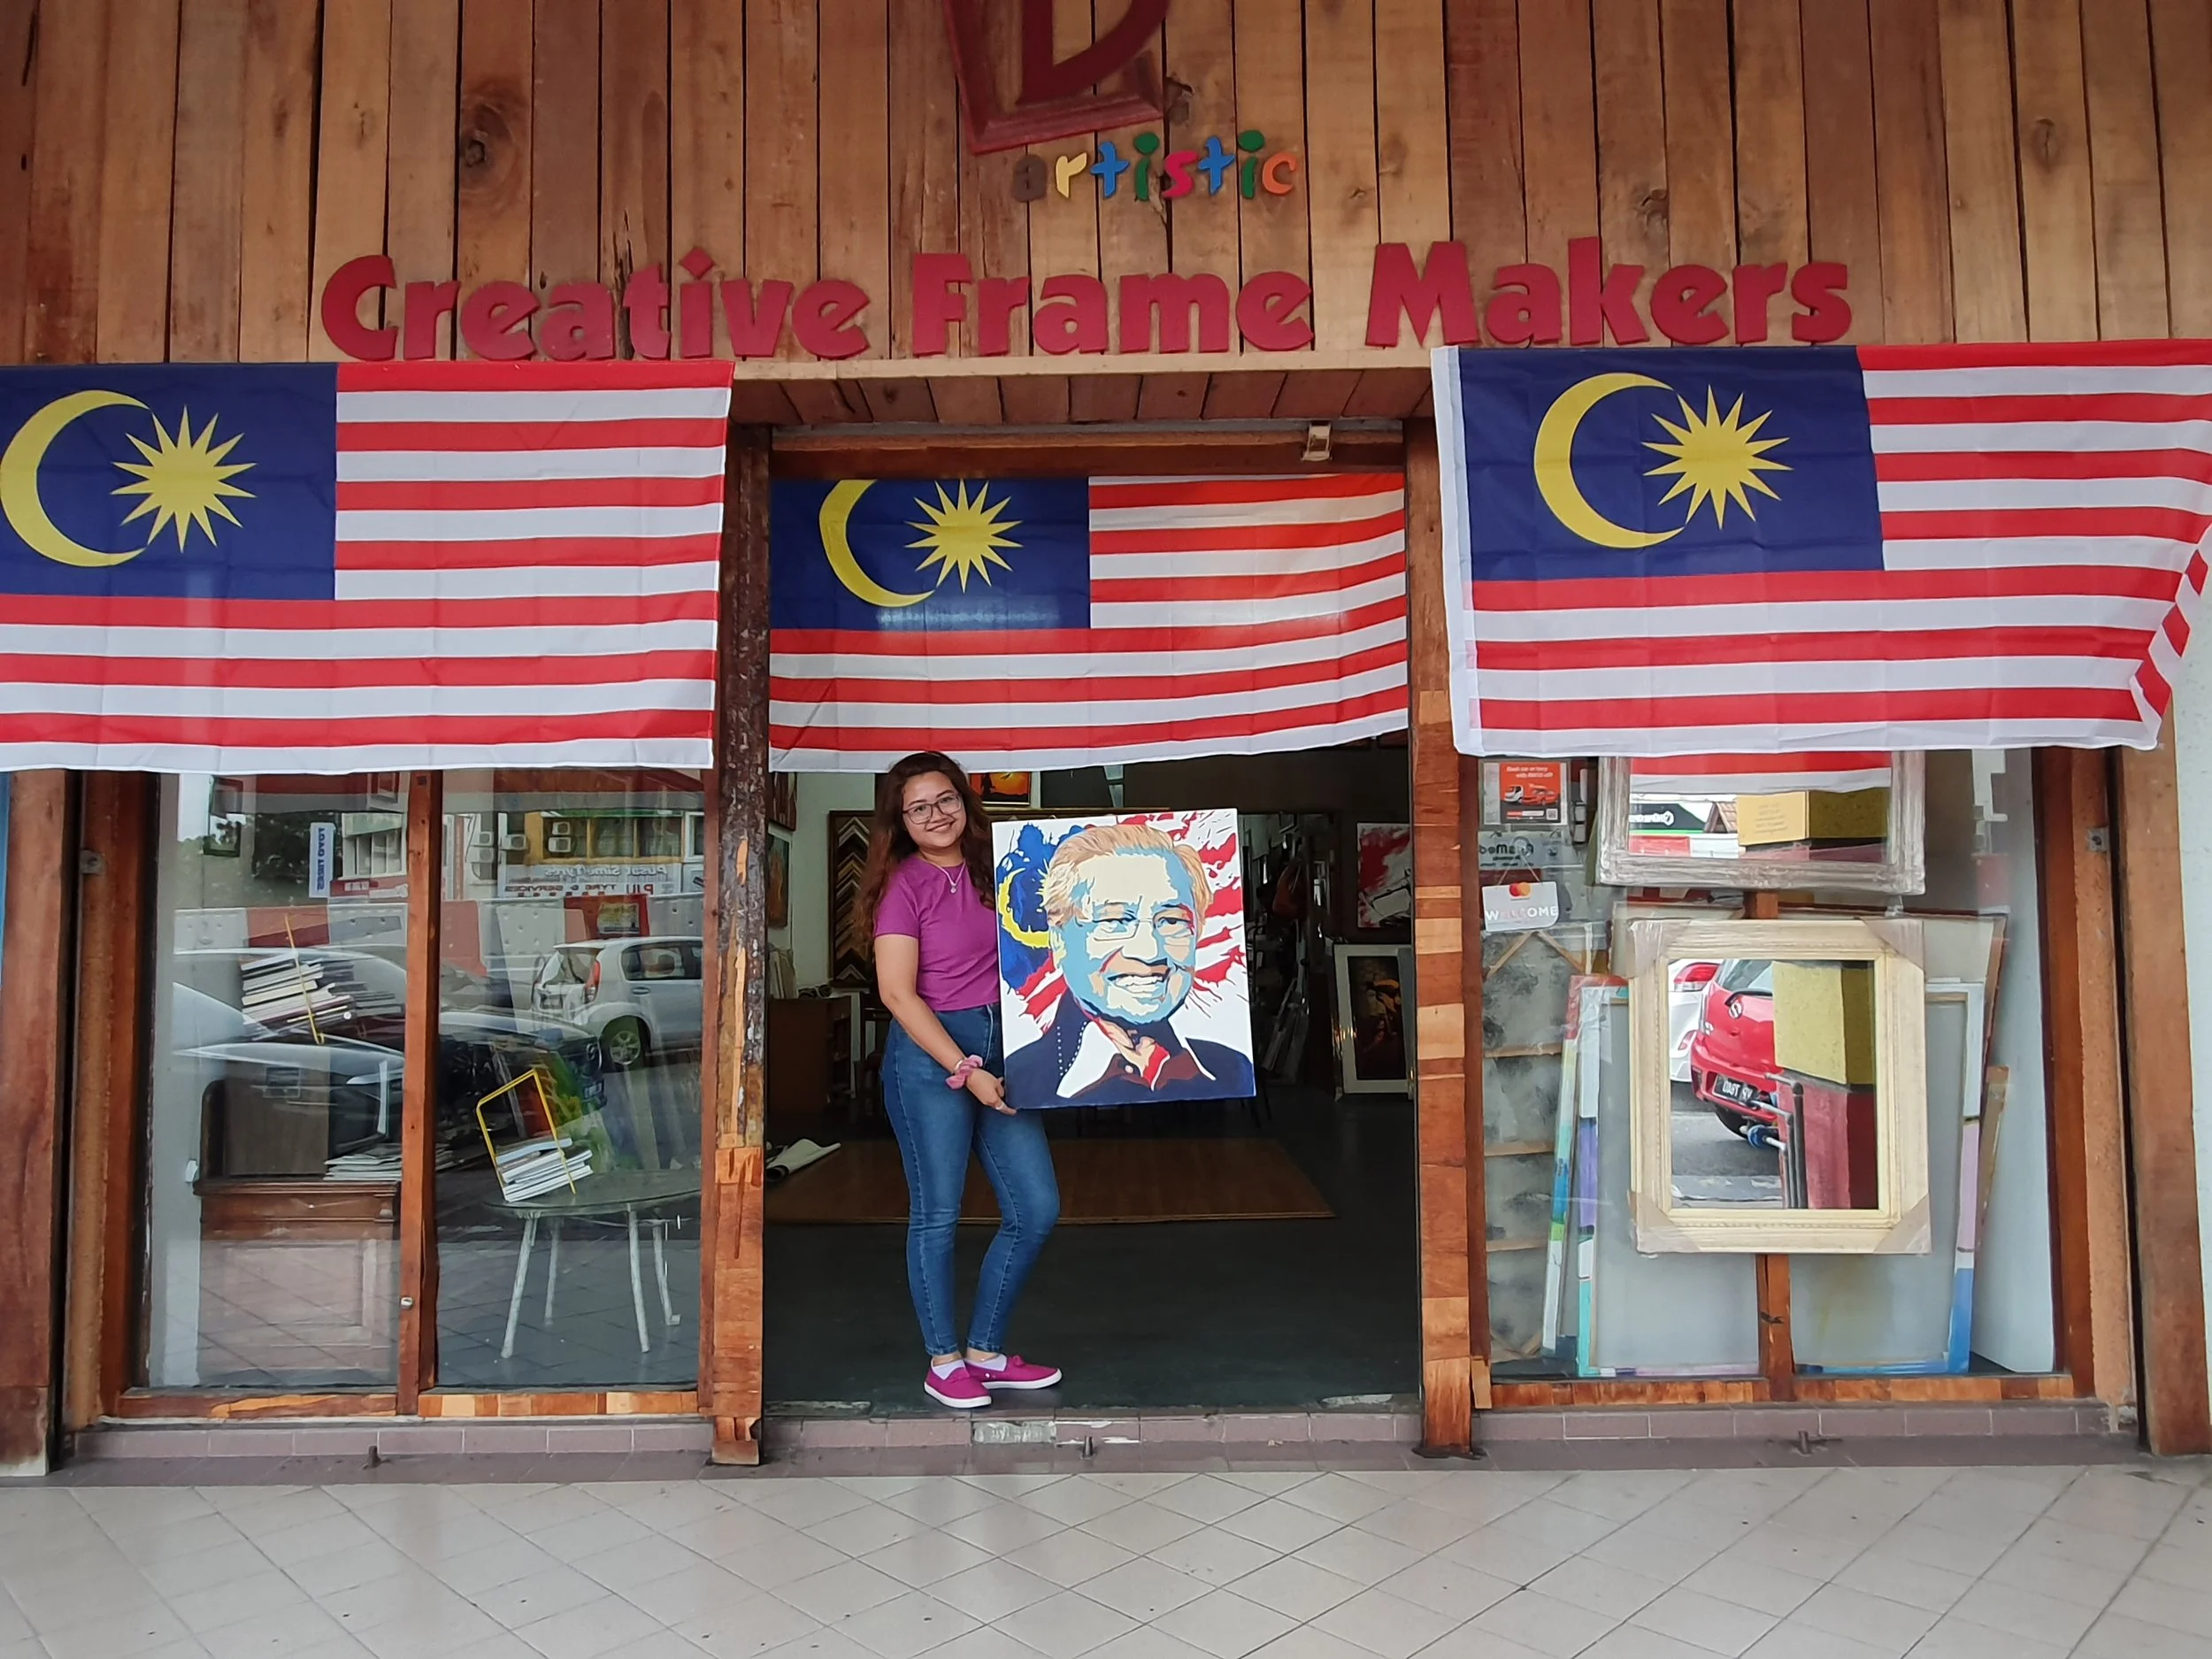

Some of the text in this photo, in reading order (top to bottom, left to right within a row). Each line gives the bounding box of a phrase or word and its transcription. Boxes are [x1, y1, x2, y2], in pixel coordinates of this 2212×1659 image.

[1012, 129, 1297, 202] artistic
[321, 236, 1852, 360] Creative Frame Makers
